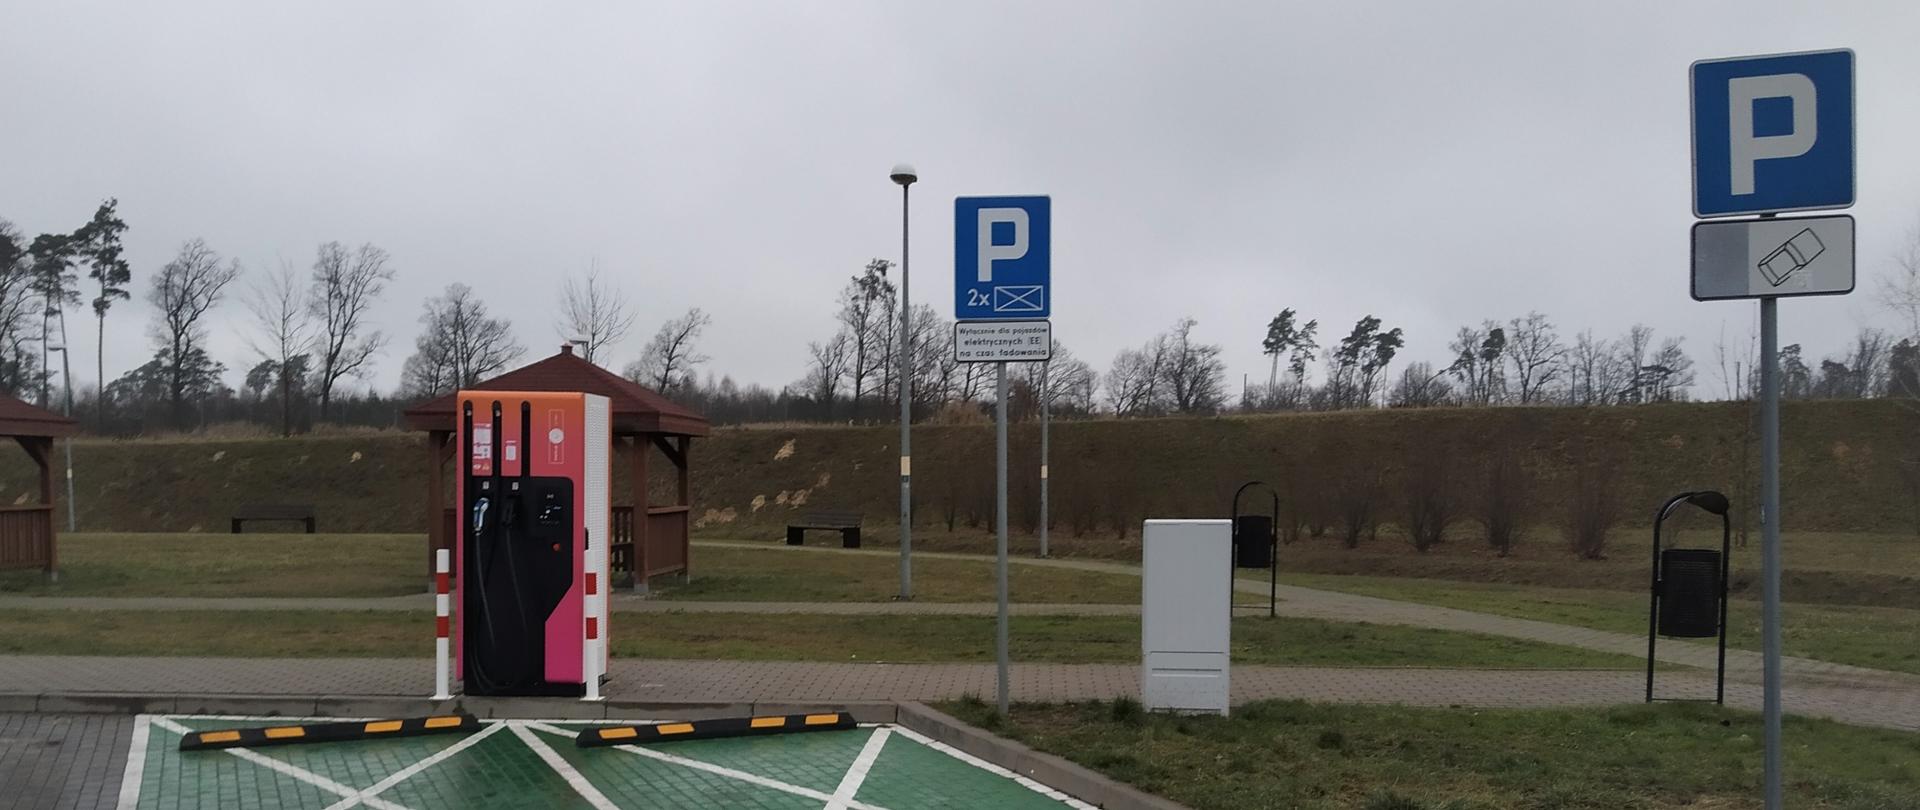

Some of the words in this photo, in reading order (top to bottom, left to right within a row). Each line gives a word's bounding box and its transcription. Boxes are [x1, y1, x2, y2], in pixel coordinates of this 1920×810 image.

[1728, 73, 1817, 196] P
[977, 207, 1030, 282] P
[967, 288, 990, 307] 2x
[964, 338, 1023, 347] elektrycznych
[999, 348, 1047, 356] ładowania
